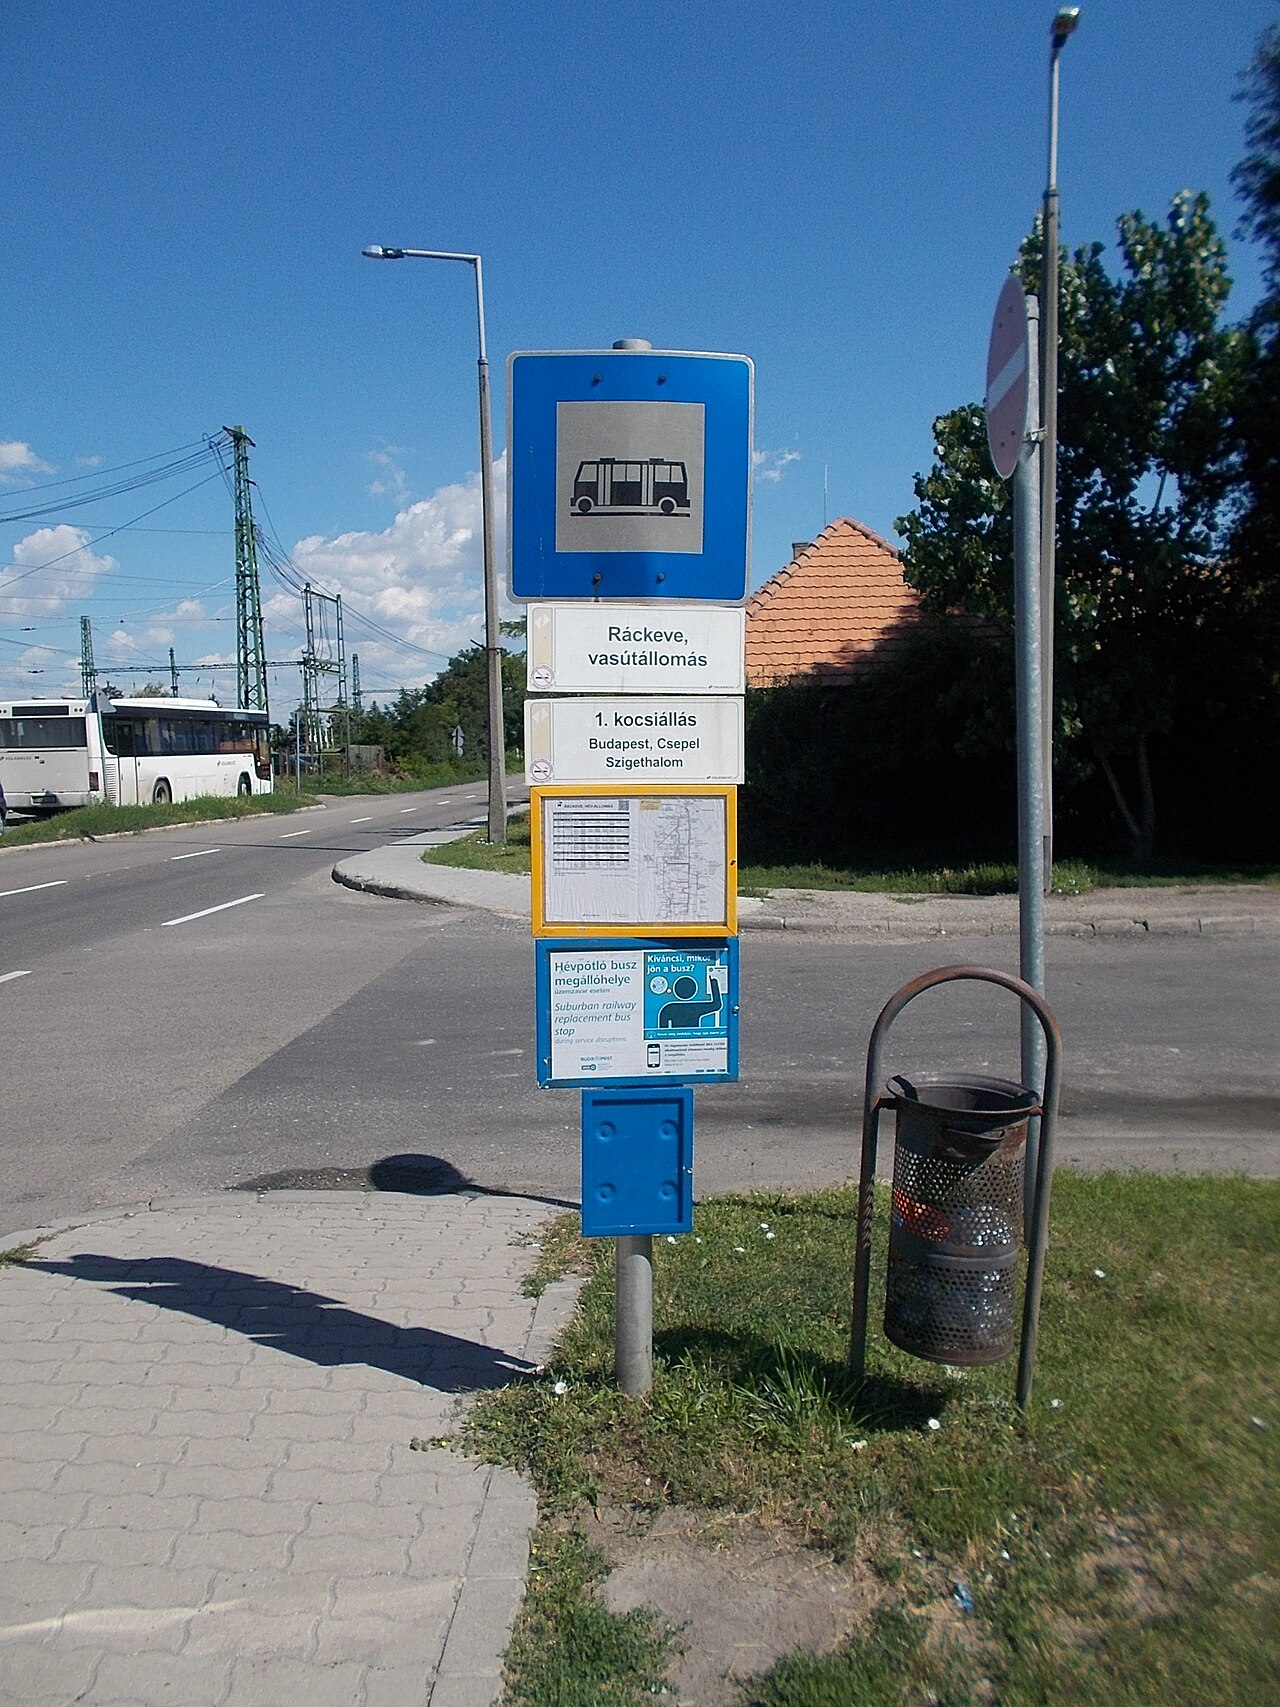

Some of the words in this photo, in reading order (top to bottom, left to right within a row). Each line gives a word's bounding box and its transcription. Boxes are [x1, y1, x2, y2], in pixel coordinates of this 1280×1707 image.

[608, 626, 689, 645] Ráckeve,
[588, 651, 708, 667] vasútállomás
[595, 712, 608, 727] 1.
[614, 712, 697, 727] kocsiállás
[589, 738, 653, 751] Budapest,
[657, 738, 700, 751] Csepel
[605, 756, 683, 770] Szigethalom
[554, 961, 607, 973] Hévpótló
[610, 960, 637, 970] busz
[646, 965, 661, 975] jön
[670, 964, 695, 973] busz?
[554, 974, 631, 988] megállóhelye
[554, 1002, 600, 1012] Suburban
[602, 1001, 637, 1011] railway
[554, 1014, 612, 1025] replacement
[614, 1013, 632, 1022] bus
[554, 1027, 575, 1037] stop
